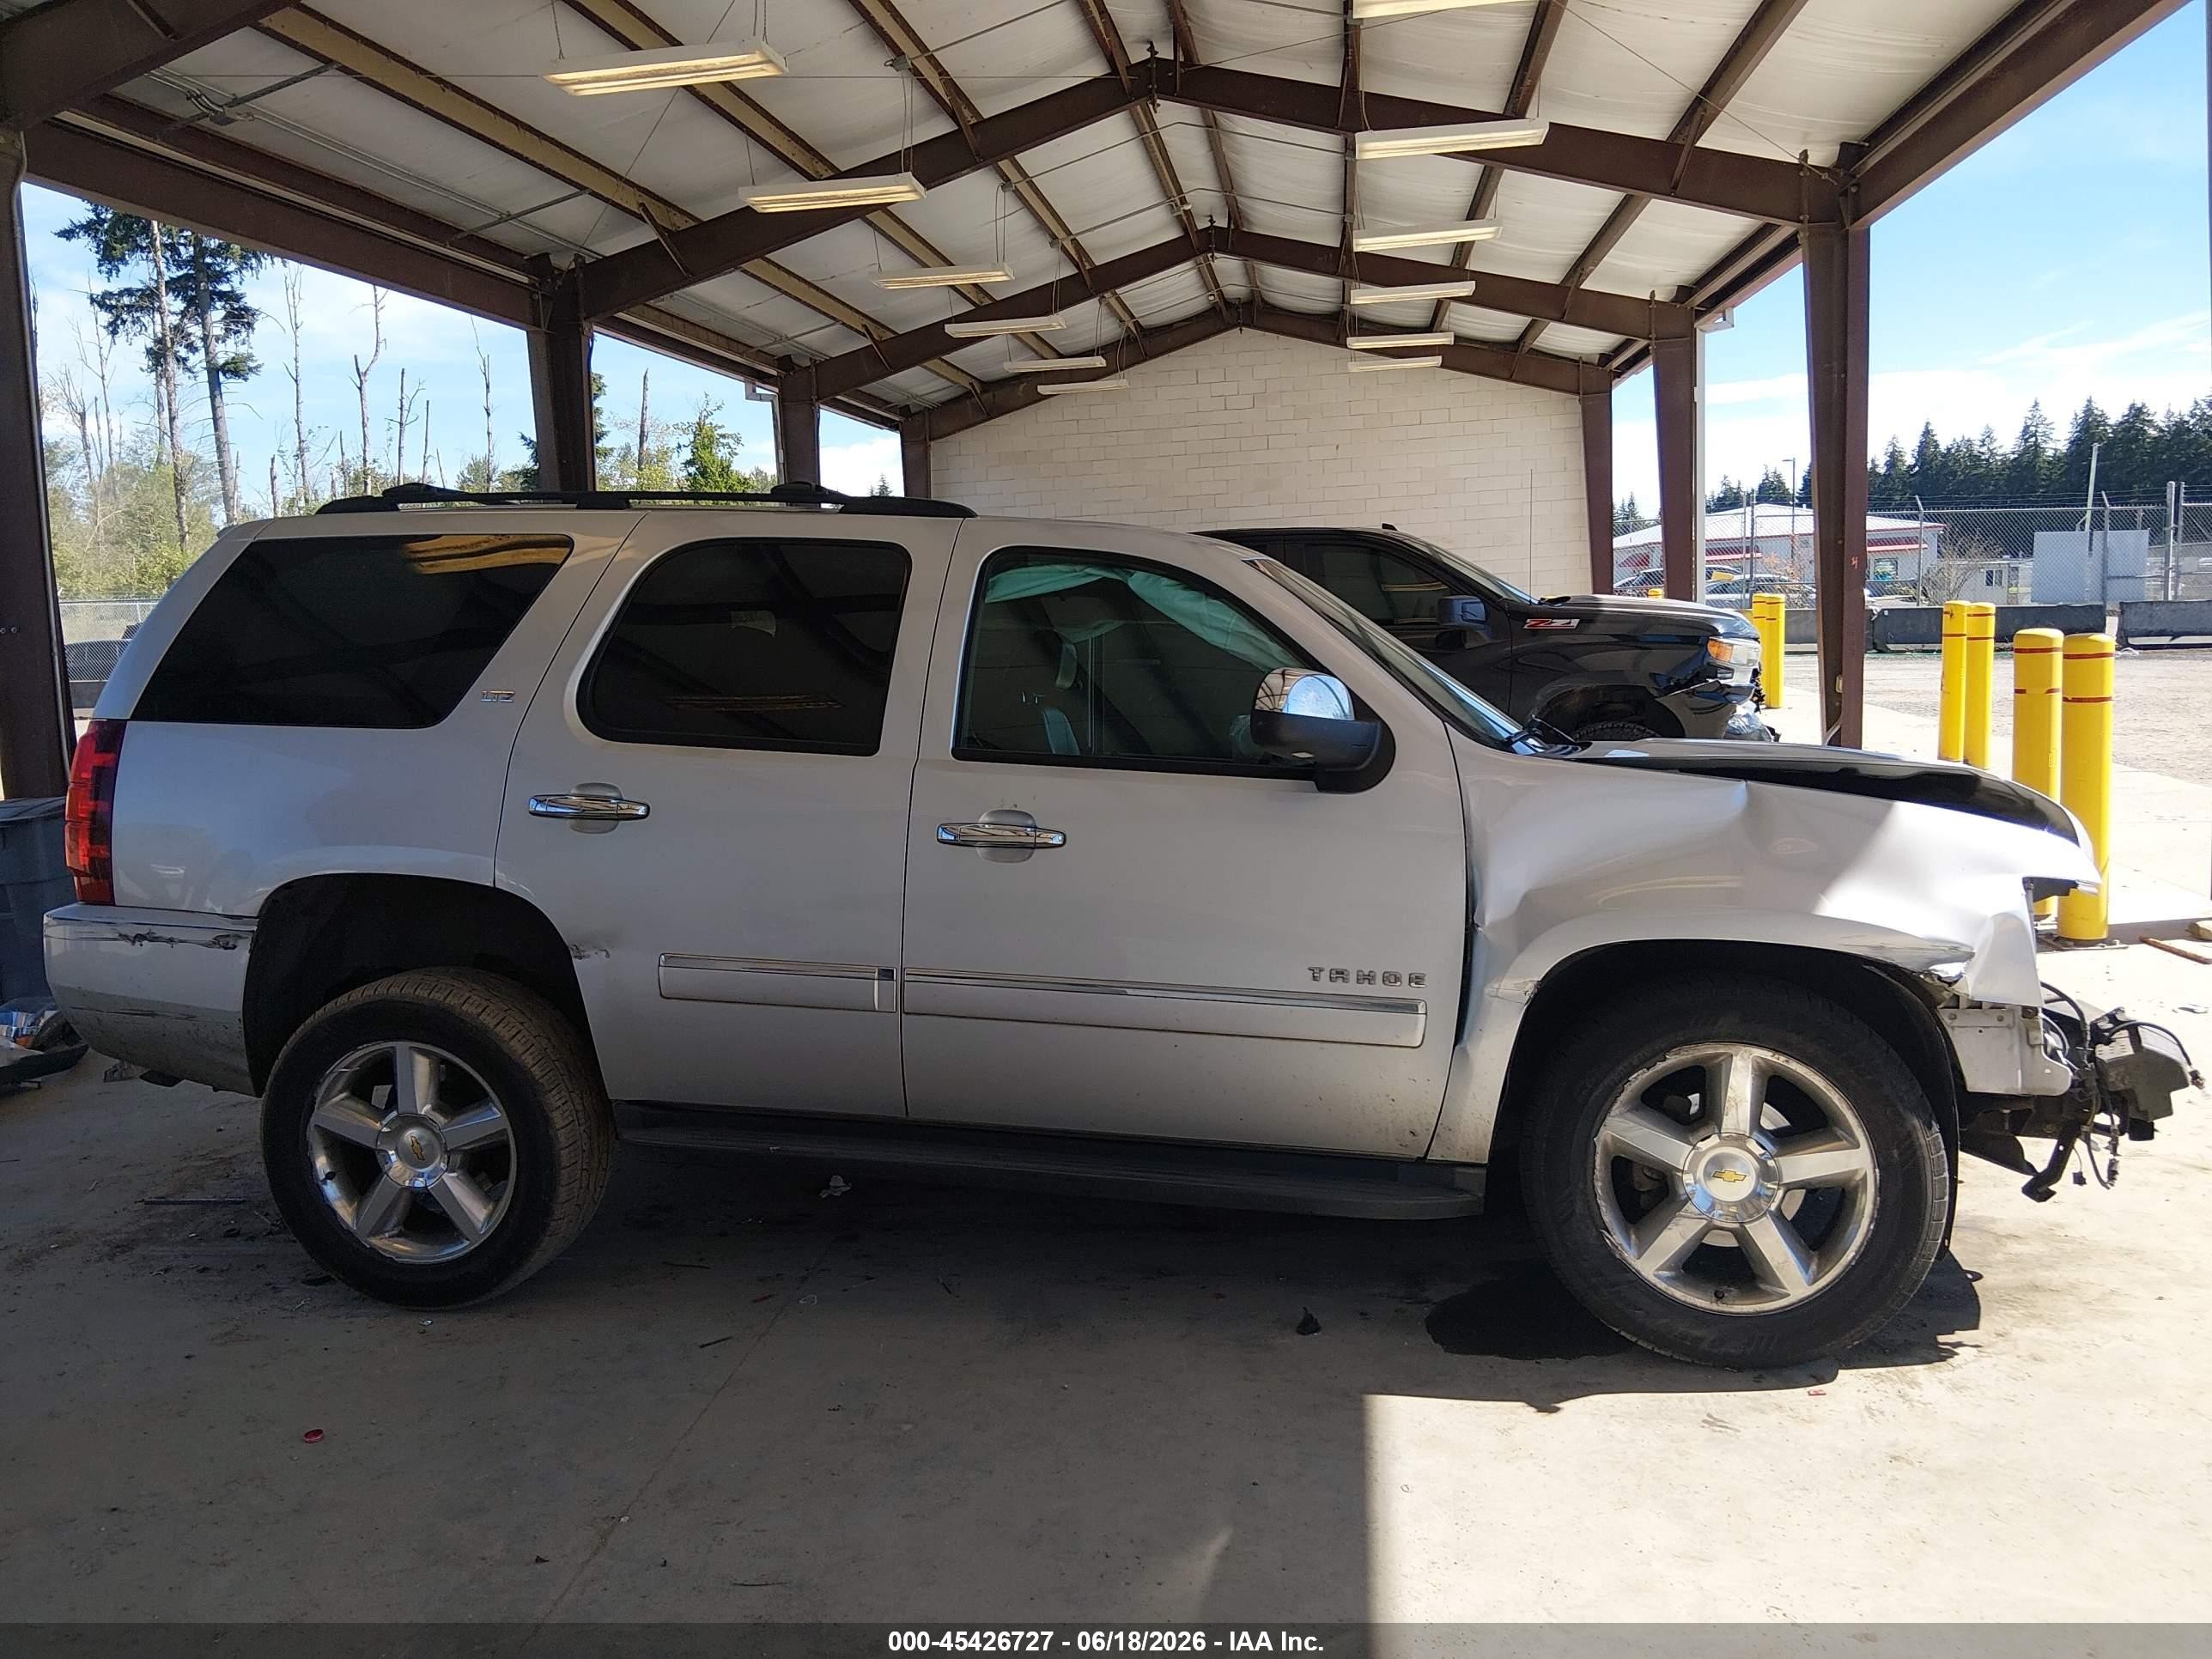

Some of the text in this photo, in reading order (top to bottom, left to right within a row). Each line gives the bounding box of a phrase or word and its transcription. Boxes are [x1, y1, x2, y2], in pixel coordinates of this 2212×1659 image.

[1523, 618, 1580, 629] Z71
[481, 690, 515, 702] LTZ
[1308, 966, 1427, 988] TAHOE
